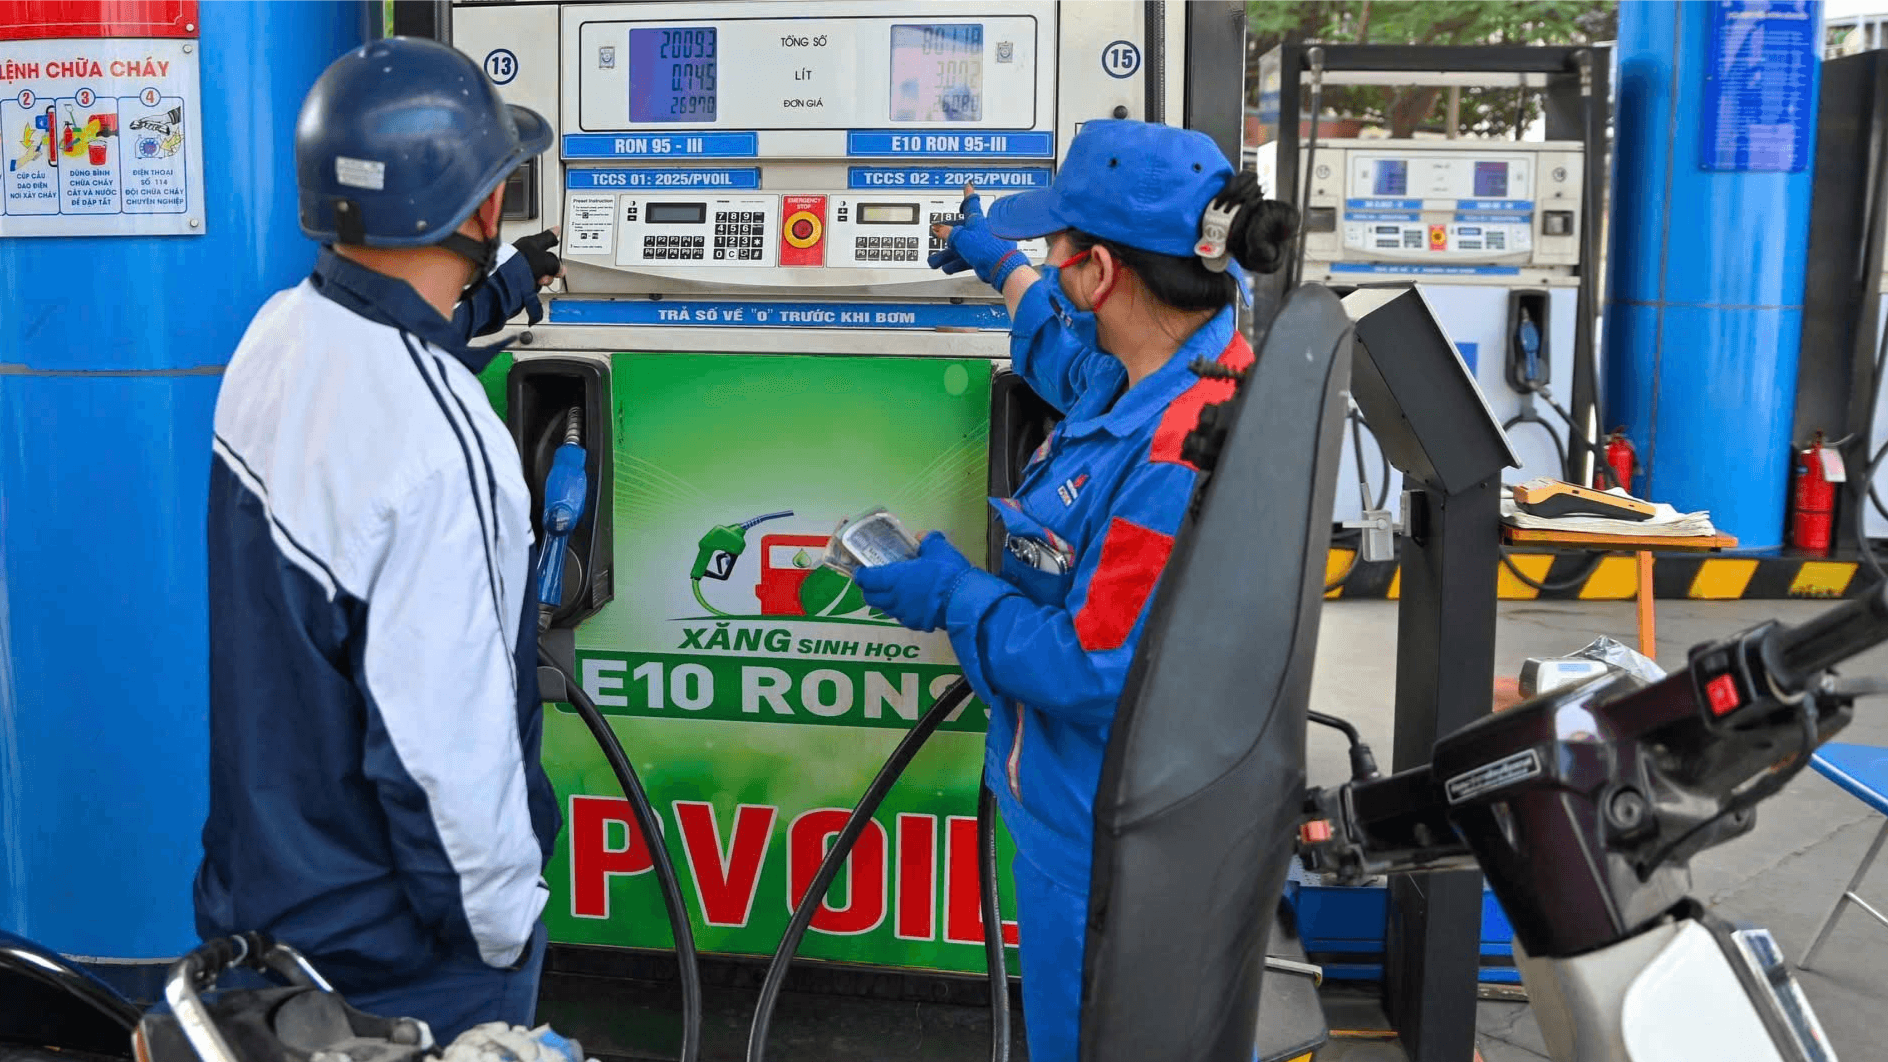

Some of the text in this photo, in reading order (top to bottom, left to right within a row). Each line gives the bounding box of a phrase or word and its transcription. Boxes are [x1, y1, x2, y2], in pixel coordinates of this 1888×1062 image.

[660, 30, 715, 59] 20093
[781, 34, 827, 47] TỔNG SỐ
[1111, 48, 1133, 69] 15
[0, 56, 170, 84] LỆNH CHỮA CHÁY
[492, 57, 512, 75] 13
[795, 67, 812, 80] LÍT
[22, 92, 30, 105] 2
[81, 91, 89, 105] 3
[146, 90, 154, 103] 4
[783, 97, 824, 108] ĐƠN GIÁ
[670, 96, 715, 114] 26970
[615, 138, 647, 153] RON
[652, 138, 671, 153] 95
[687, 138, 703, 153] III
[892, 136, 1007, 152] E10 RON 95-III
[592, 173, 732, 186] TCCS 01: 2025/PVOIL
[864, 172, 905, 185] TCCS
[910, 172, 929, 185] 02
[944, 172, 1036, 186] 2025/PVOIL
[717, 212, 724, 220] 7
[730, 212, 737, 220] 8
[743, 212, 750, 220] 9
[717, 224, 749, 232] 4 5 6
[716, 250, 723, 258] 0
[728, 250, 735, 258] C
[658, 305, 690, 321] TRẢ
[695, 306, 718, 321] SỐ
[780, 308, 836, 323] TRƯỚC
[841, 311, 870, 323] KHI
[876, 310, 915, 323] BƠM
[677, 622, 921, 661] XĂNG SINH HỌC
[582, 658, 714, 711] E10
[568, 794, 1020, 948] PVOIL
